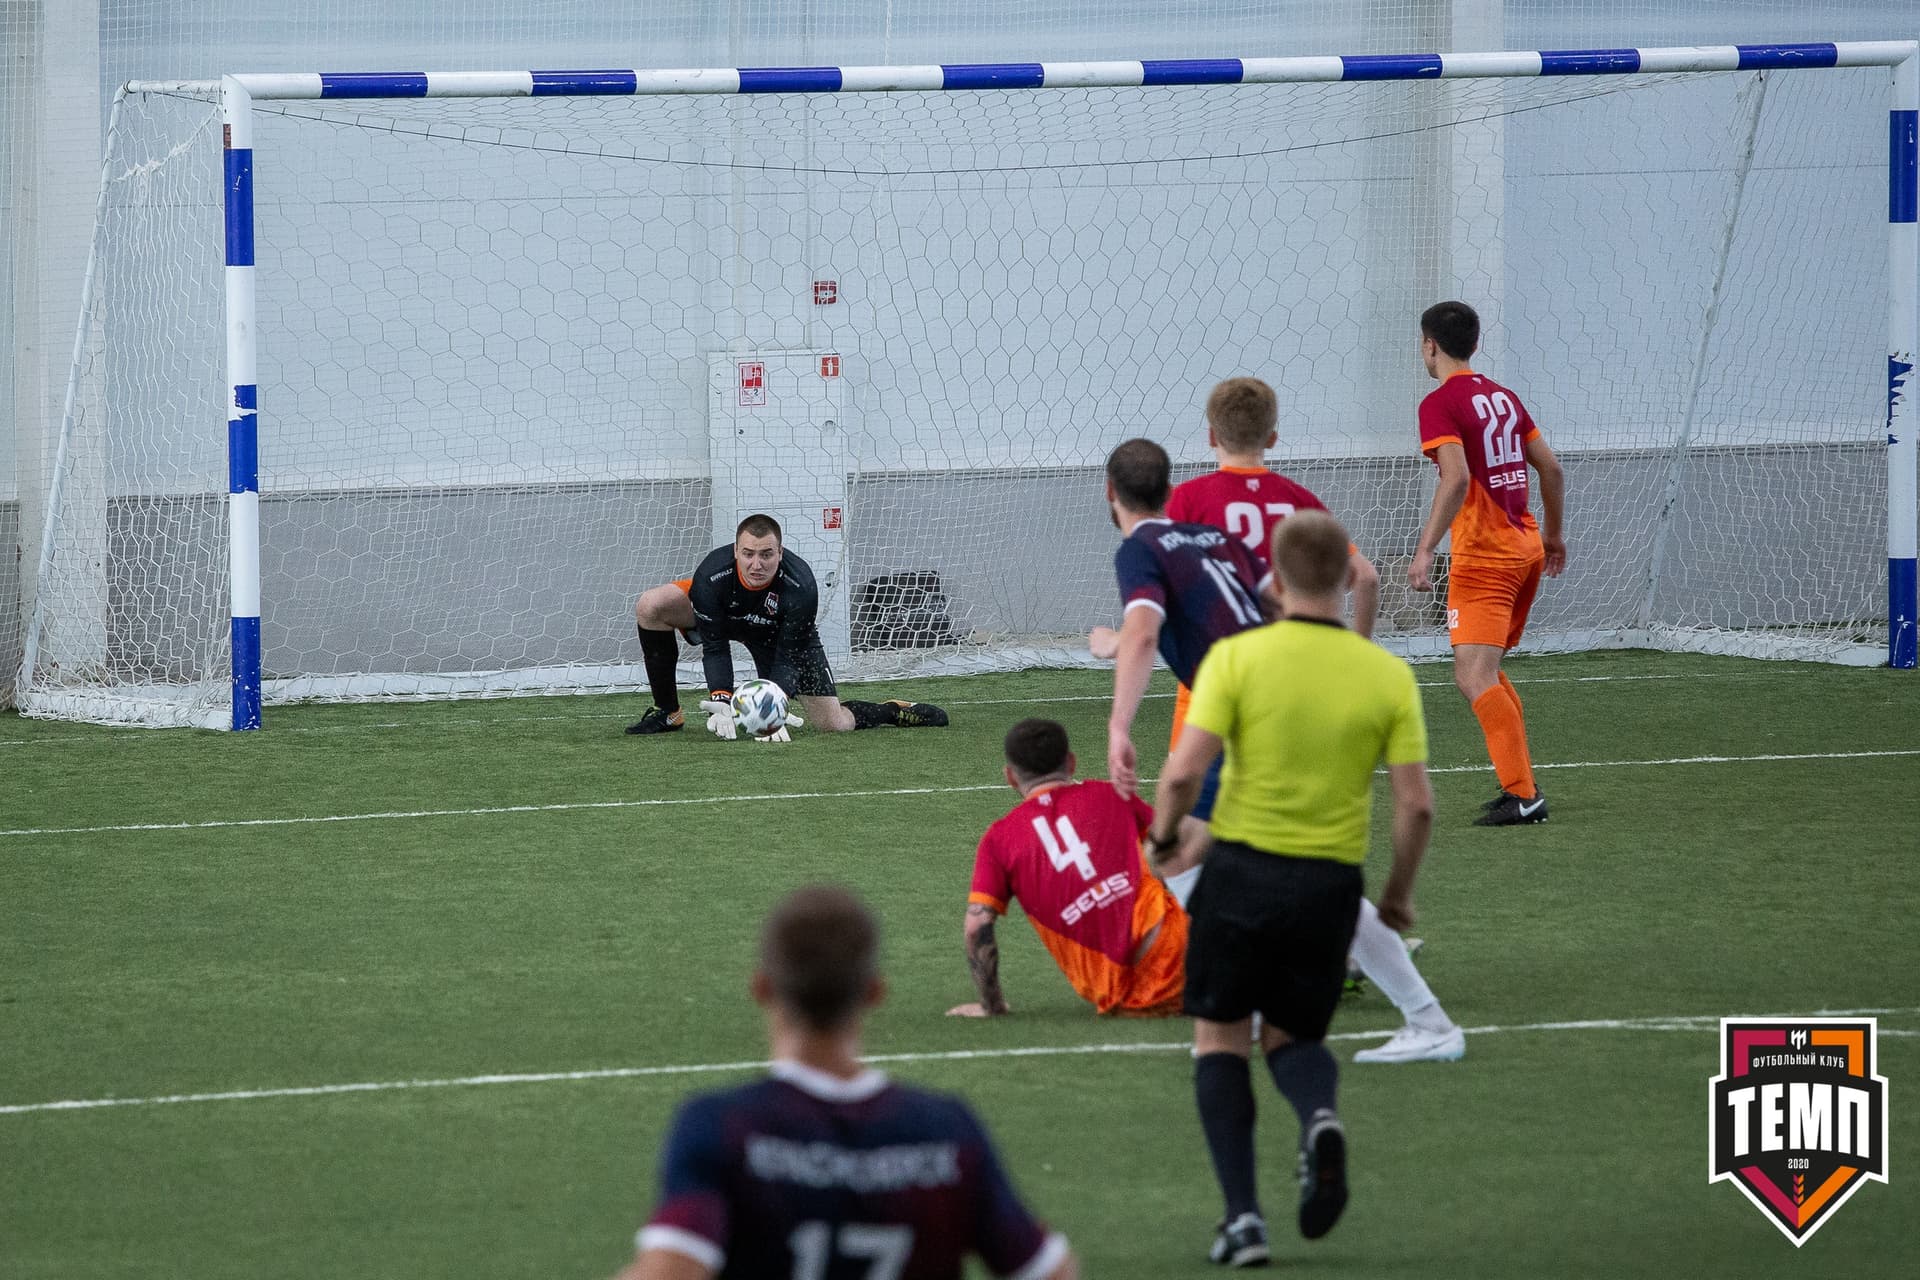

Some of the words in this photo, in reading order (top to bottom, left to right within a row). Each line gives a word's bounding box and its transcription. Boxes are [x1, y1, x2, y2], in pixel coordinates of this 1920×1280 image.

[1472, 391, 1523, 468] 22
[1224, 501, 1296, 554] 2
[1031, 814, 1097, 881] 4
[1060, 872, 1130, 926] SEUS
